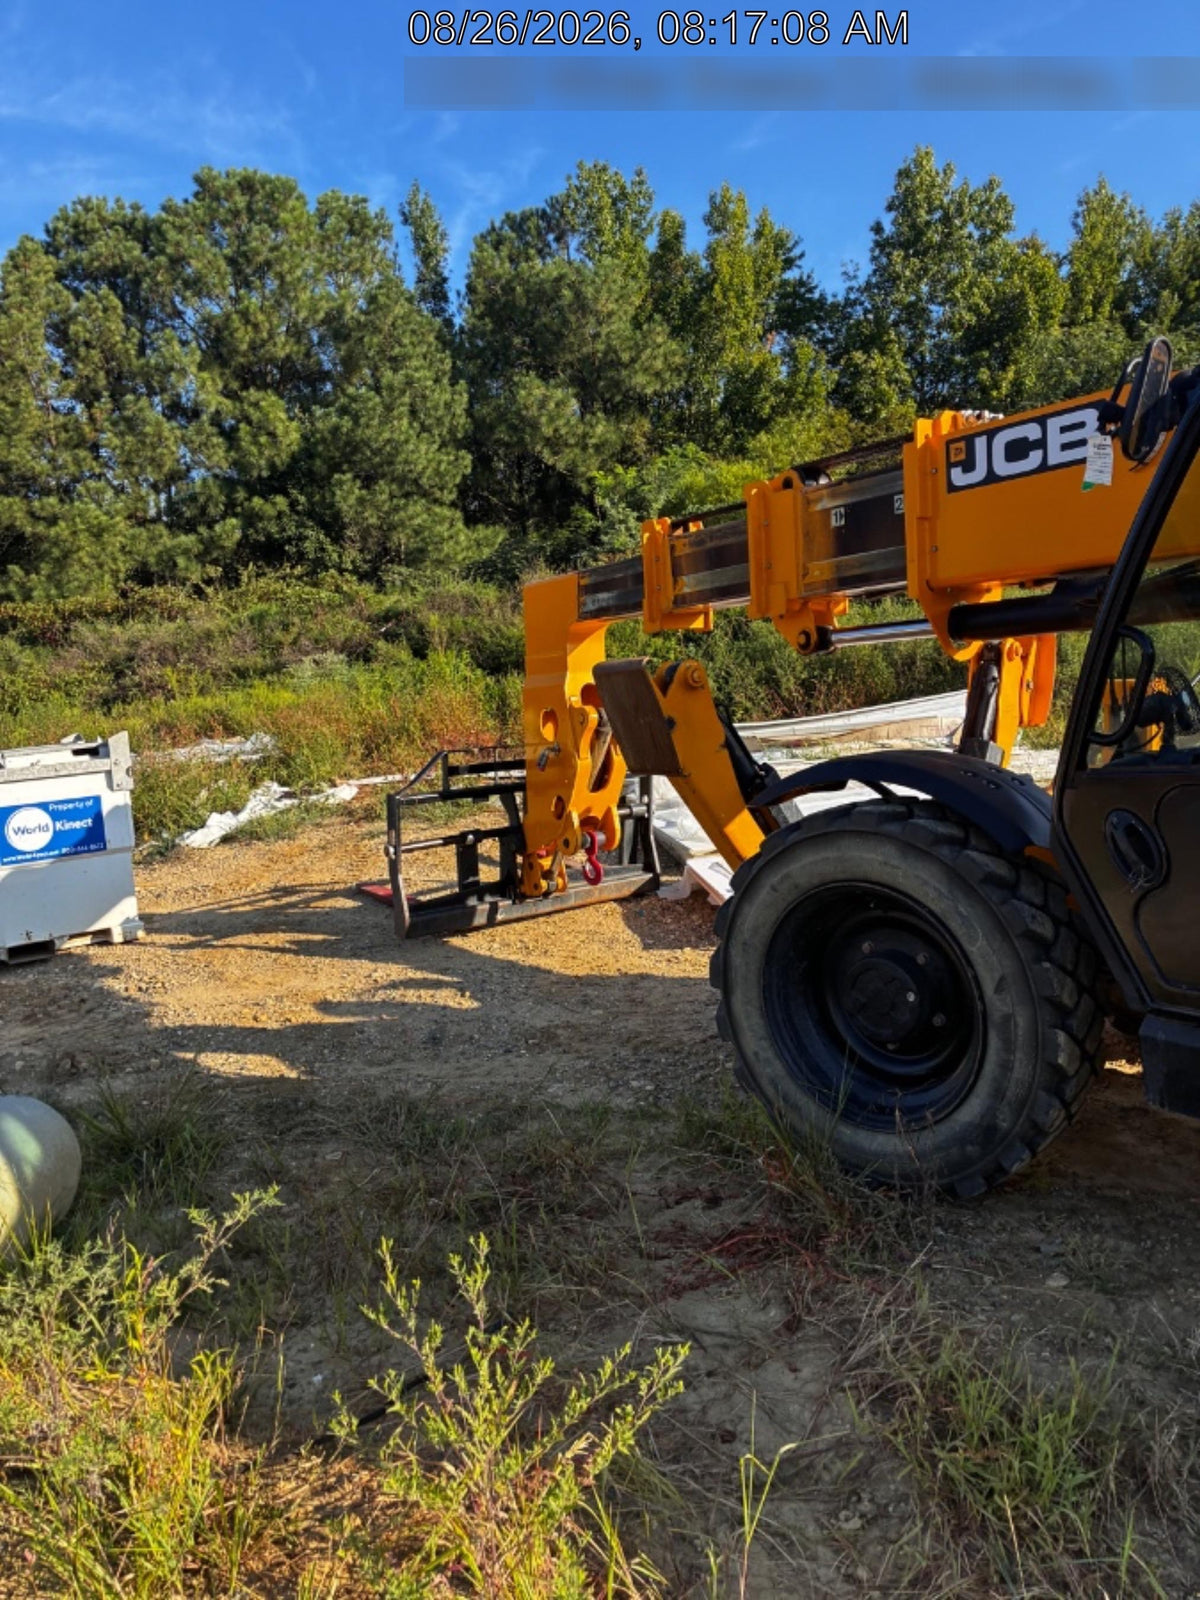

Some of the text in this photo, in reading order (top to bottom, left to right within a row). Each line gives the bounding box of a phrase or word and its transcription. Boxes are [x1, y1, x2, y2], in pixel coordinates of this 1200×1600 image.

[950, 408, 1100, 486] JCB
[49, 799, 94, 812] Property of
[12, 817, 94, 836] World Kinect
